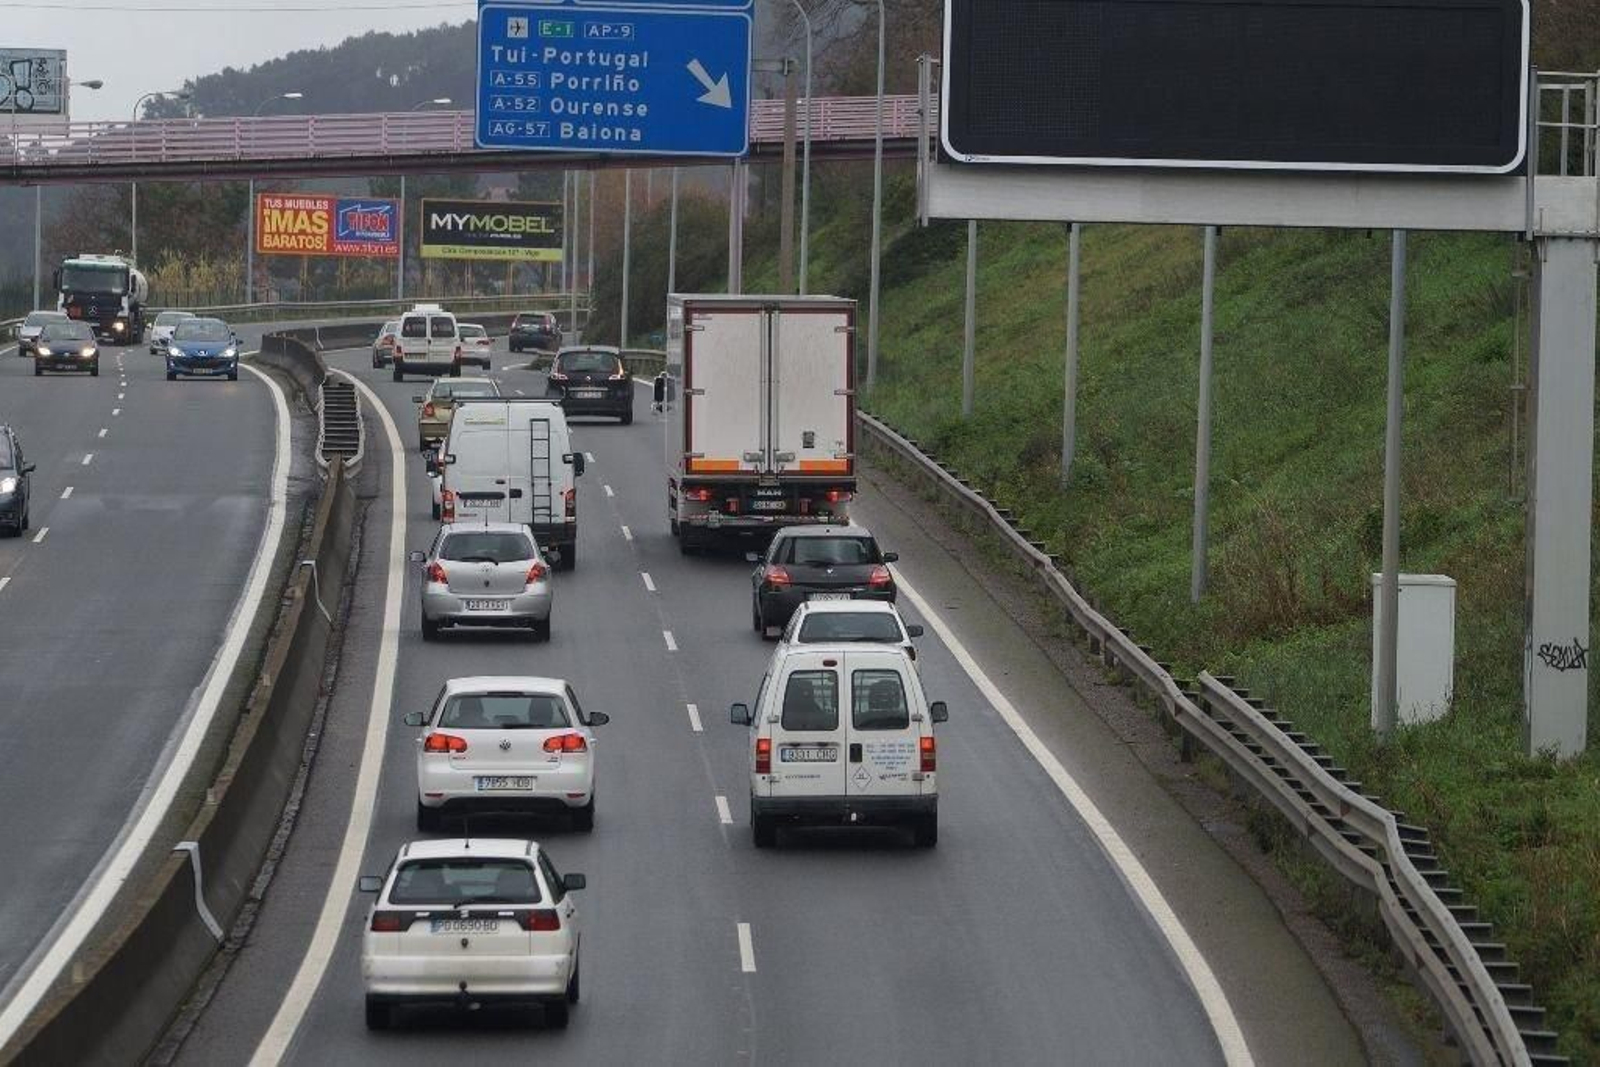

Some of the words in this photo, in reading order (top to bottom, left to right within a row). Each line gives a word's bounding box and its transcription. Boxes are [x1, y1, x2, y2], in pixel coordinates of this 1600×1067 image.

[542, 22, 572, 36] E-1
[588, 25, 631, 39] AP-9
[491, 45, 649, 71] Tui-Portugal
[494, 73, 538, 86] A-55
[550, 73, 640, 92] Porriño
[493, 97, 538, 111] A-52
[550, 98, 648, 116] Ourense
[493, 123, 547, 136] AG-57
[560, 123, 642, 142] Baiona
[264, 199, 282, 209] TUS
[285, 199, 329, 210] MUEBLES
[430, 213, 555, 233] MYMOBEL
[263, 234, 327, 250] BARATOS!
